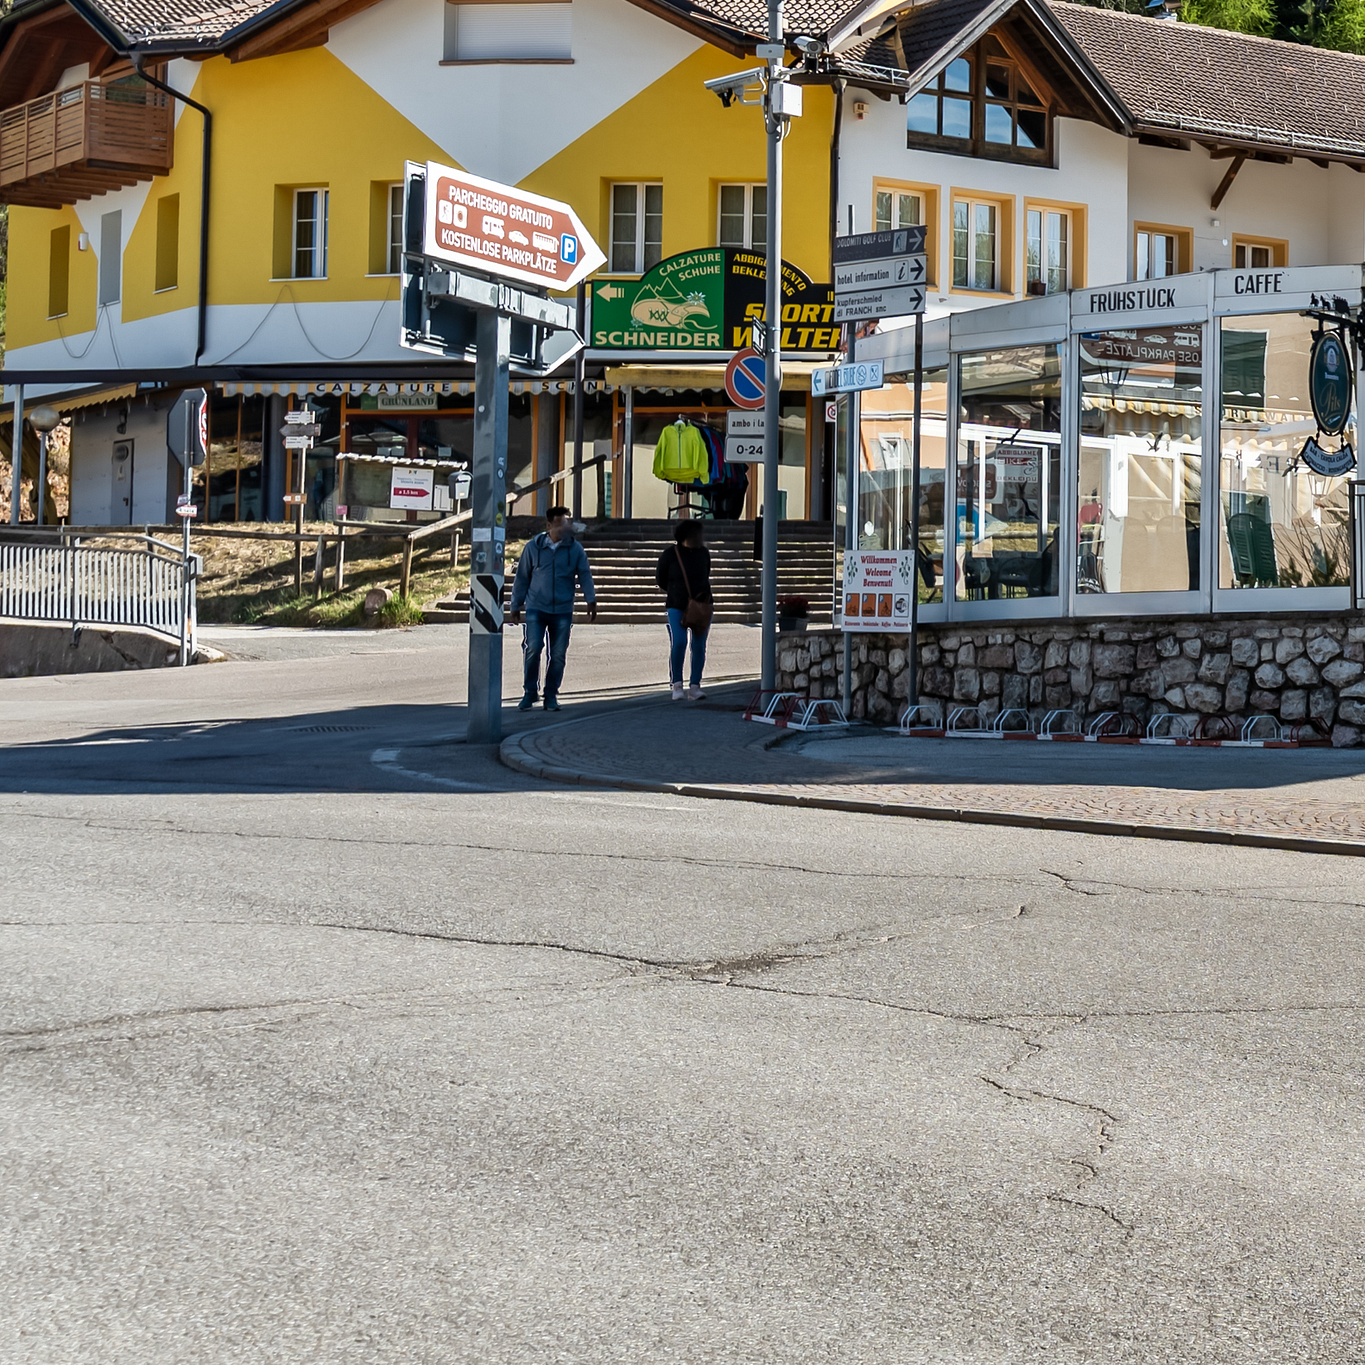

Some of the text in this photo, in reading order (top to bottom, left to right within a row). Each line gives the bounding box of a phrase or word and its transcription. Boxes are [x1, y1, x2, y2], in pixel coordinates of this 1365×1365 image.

[448, 185, 553, 230] PARCHEGGIO GRATUITO
[836, 234, 891, 248] DOLOMITI GOLF CLUB
[442, 228, 557, 274] KOSTENLOSE PARKPLÄTZE
[659, 253, 721, 277] CALZATURE
[733, 253, 808, 292] ABBIGMENTO
[678, 266, 720, 281] SCHUHE
[838, 274, 853, 284] hotel
[855, 269, 890, 282] information
[732, 266, 796, 298] BEKLENG
[744, 304, 834, 323] SORT
[846, 306, 872, 316] FRANCH
[595, 331, 720, 347] SCHNEIDER
[733, 326, 840, 348] WLTE
[316, 383, 450, 392] CALZATURE
[1320, 382, 1341, 418] Pils
[732, 419, 750, 427] ambo
[736, 444, 764, 455] 0-24
[1310, 446, 1318, 456] BAR
[1320, 454, 1335, 463] TAVOLA
[860, 556, 897, 564] Willkommen
[865, 568, 892, 576] Welcome
[863, 578, 894, 587] Benvenuti
